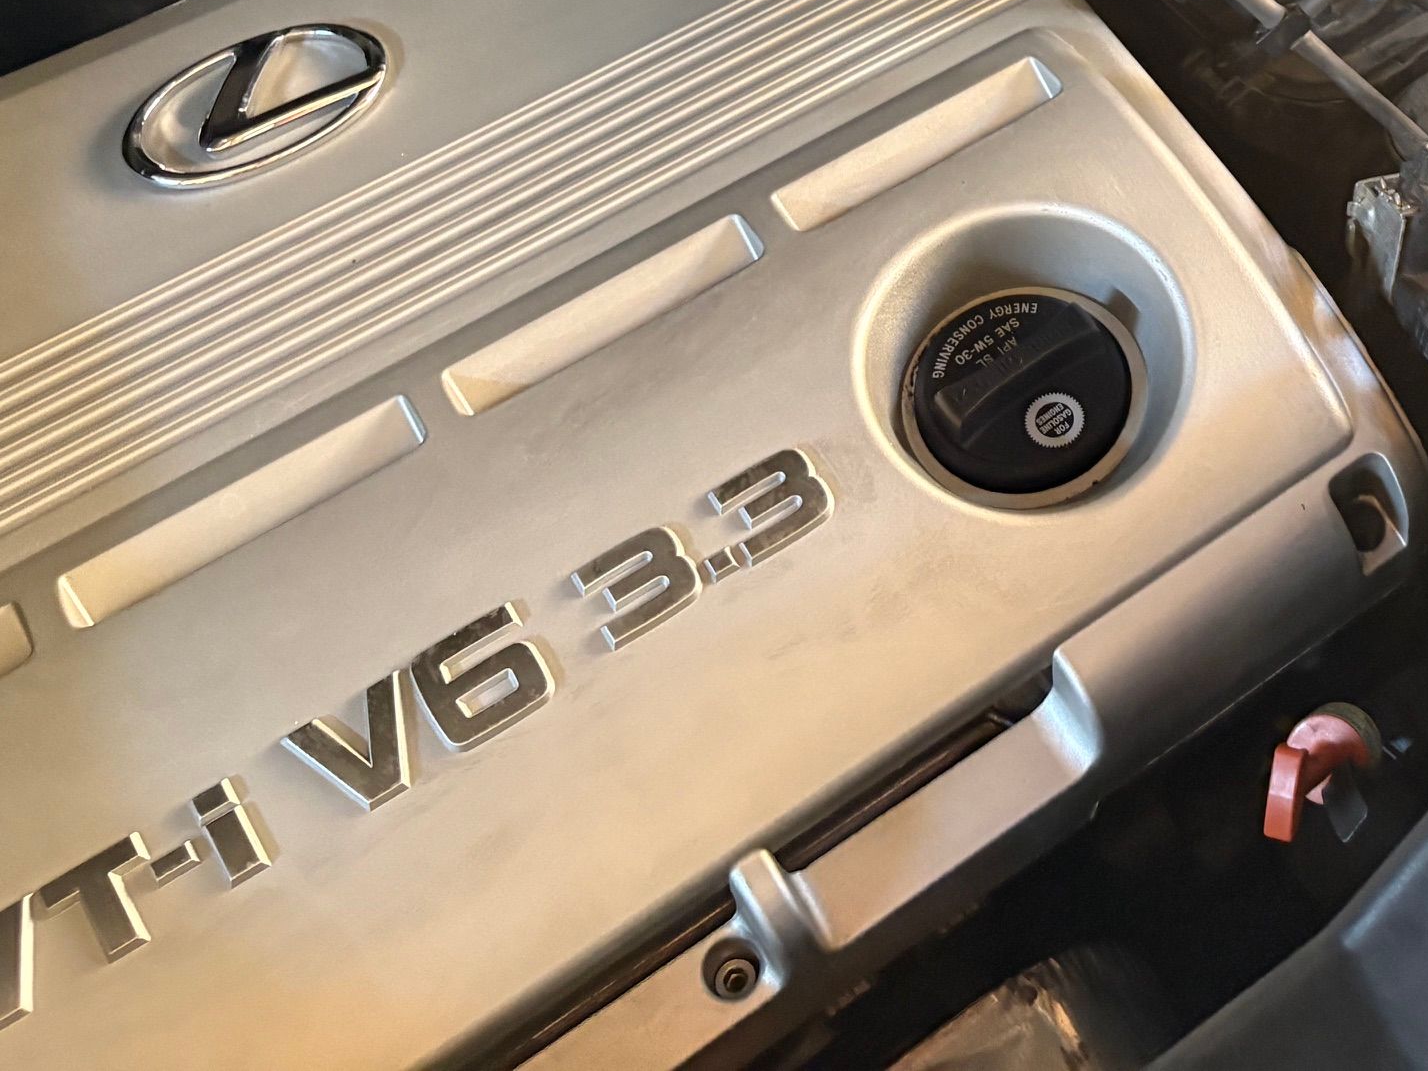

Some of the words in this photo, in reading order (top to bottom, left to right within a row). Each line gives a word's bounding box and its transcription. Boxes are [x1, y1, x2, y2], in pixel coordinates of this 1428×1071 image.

[989, 302, 1038, 319] ENERGY
[995, 317, 1020, 338] SAE
[932, 314, 985, 380] CONSERVING
[955, 334, 995, 365] 5W-30
[997, 336, 1017, 355] API
[976, 353, 995, 369] SL
[1035, 402, 1065, 424] ENGINES
[1040, 408, 1073, 435] GASOLINE
[1053, 420, 1070, 436] FOR
[0, 776, 273, 1031] T-i
[280, 601, 557, 812] V6
[569, 447, 836, 652] 3.3
